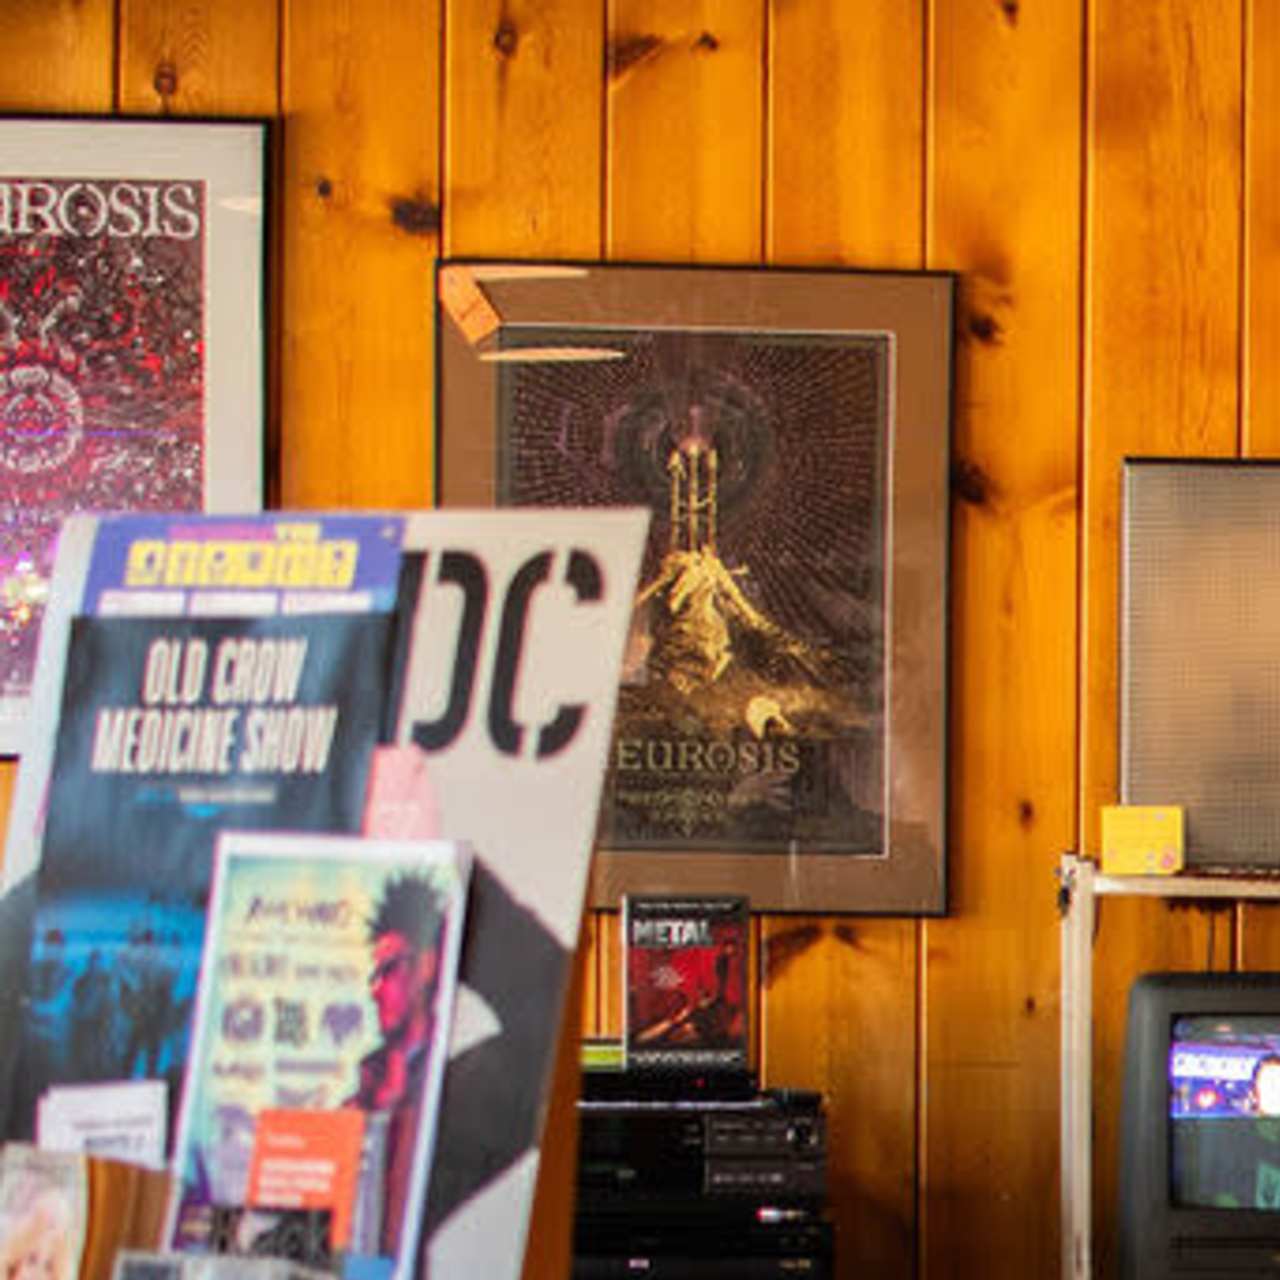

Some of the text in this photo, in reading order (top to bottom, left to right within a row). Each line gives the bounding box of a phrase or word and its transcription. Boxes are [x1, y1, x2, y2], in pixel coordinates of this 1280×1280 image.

[0, 181, 201, 240] ROSIS
[142, 636, 309, 706] OLD CROW
[90, 705, 340, 776] MEDICINE SHOW
[631, 919, 714, 948] METAL
